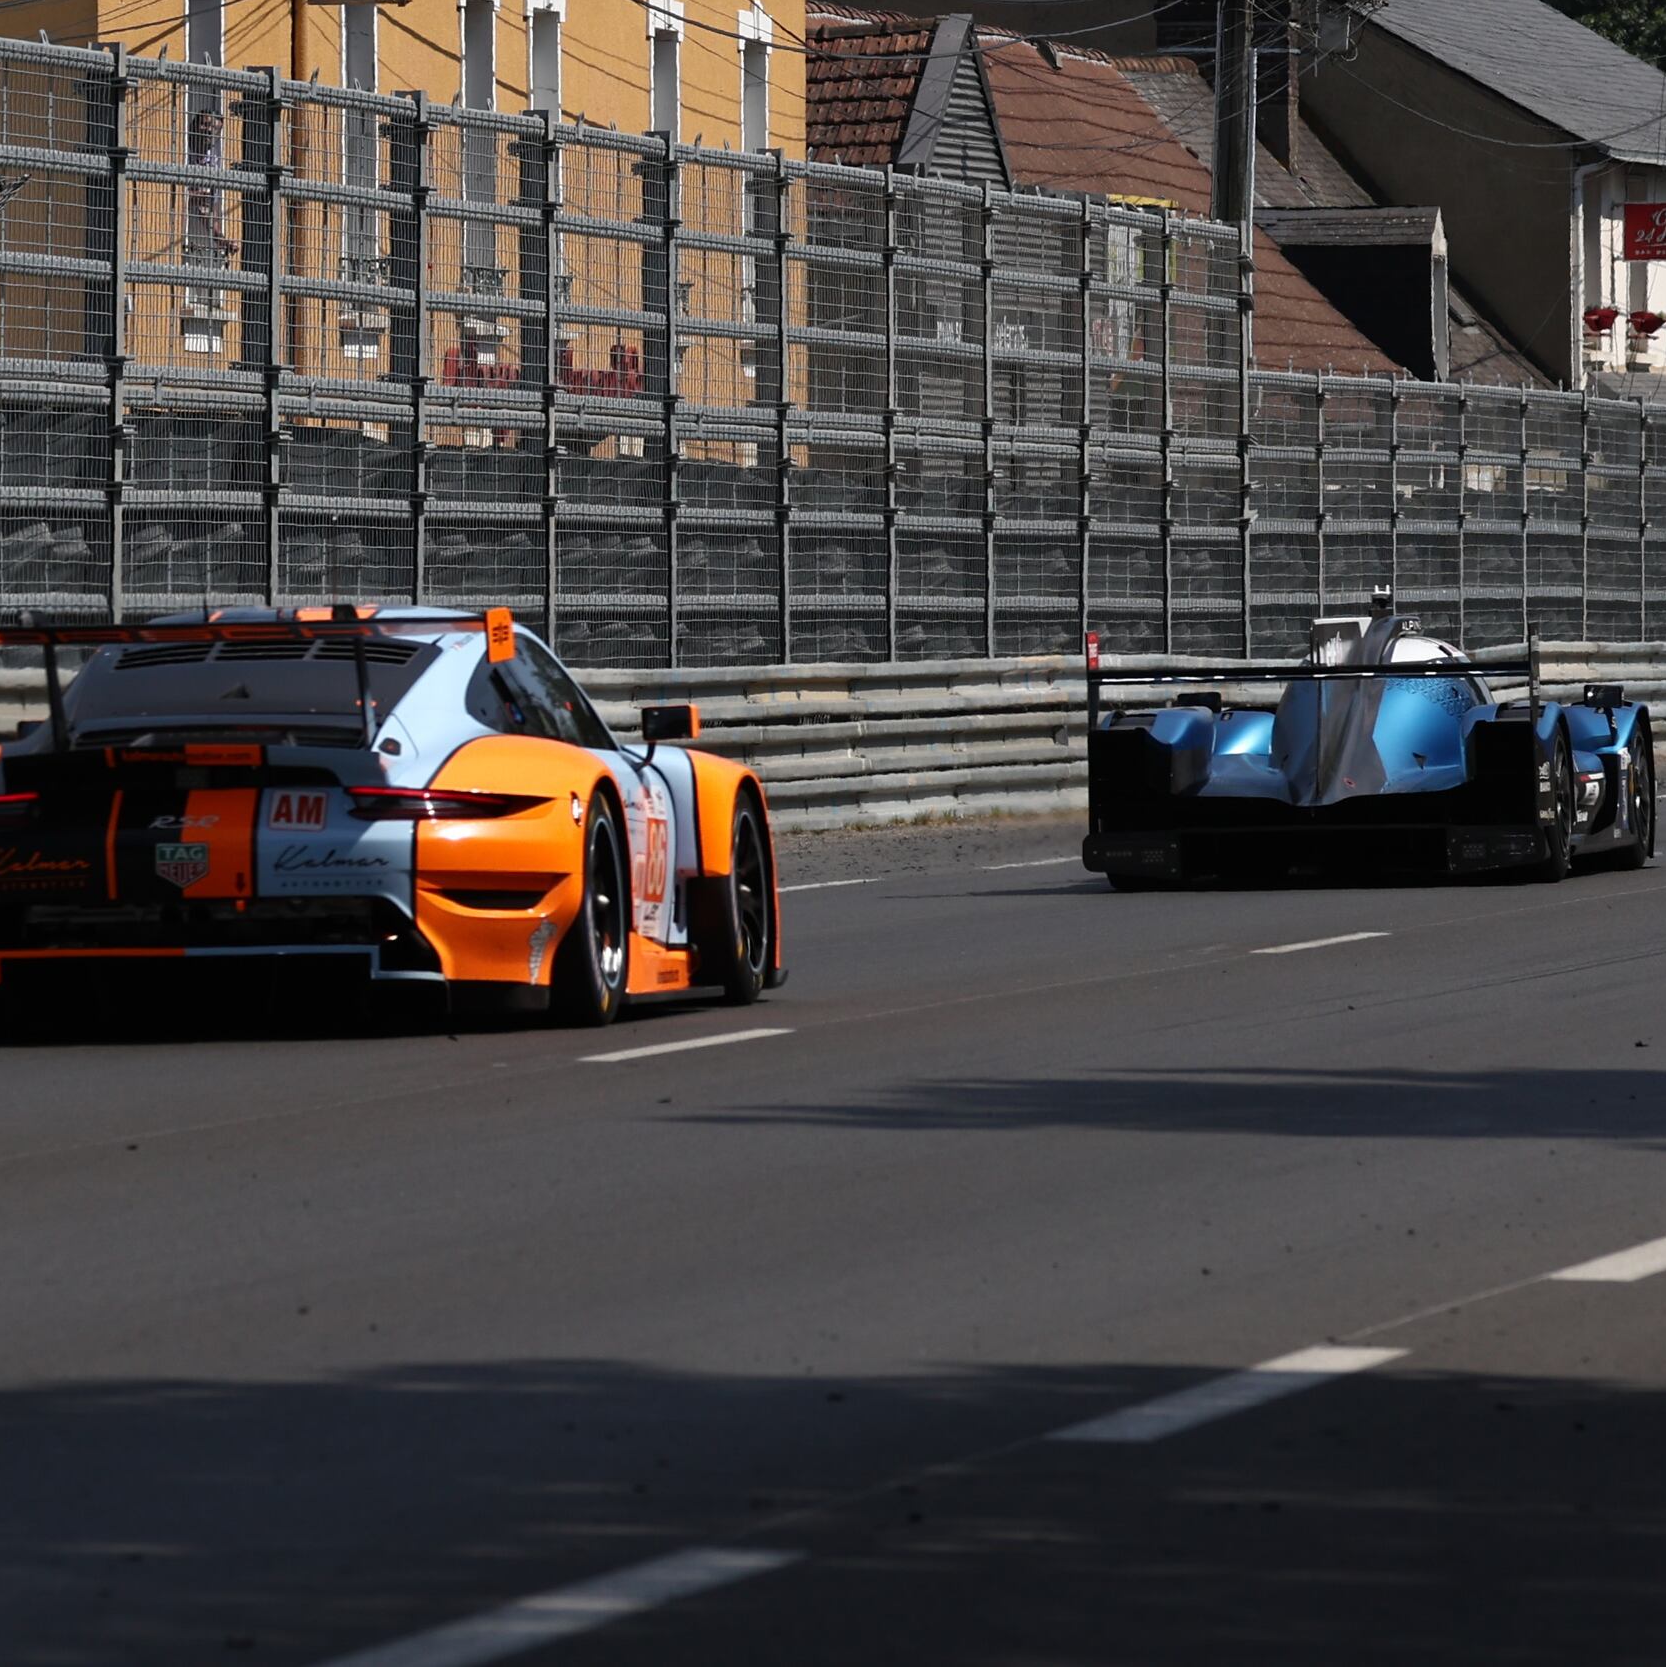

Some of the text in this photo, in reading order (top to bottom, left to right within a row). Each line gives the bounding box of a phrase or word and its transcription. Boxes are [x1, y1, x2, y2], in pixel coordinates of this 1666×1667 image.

[273, 794, 324, 825] AM
[149, 815, 220, 829] RSR
[161, 846, 203, 860] TAG
[273, 845, 389, 872] Kalmar
[156, 863, 206, 883] HEUER
